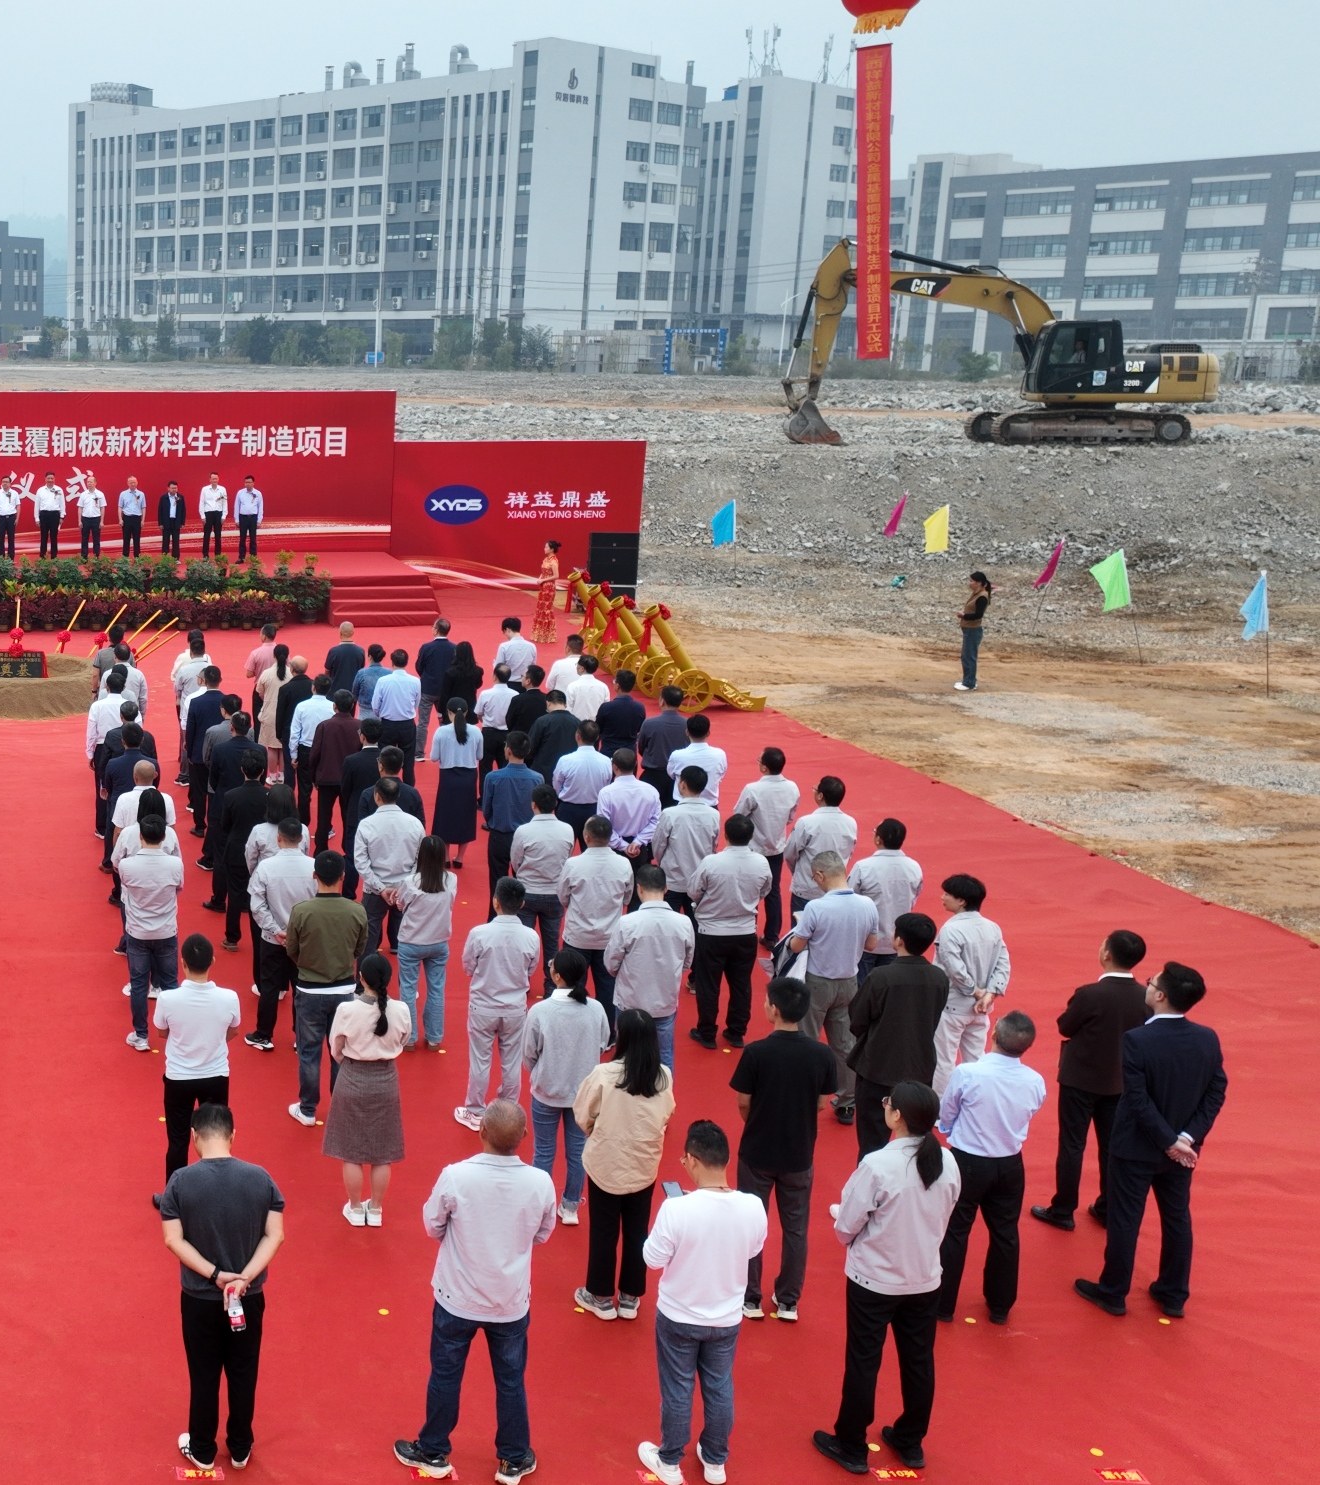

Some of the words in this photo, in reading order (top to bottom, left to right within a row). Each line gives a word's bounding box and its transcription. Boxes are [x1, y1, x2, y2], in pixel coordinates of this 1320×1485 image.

[910, 278, 937, 296] CAT
[1125, 361, 1146, 372] CAT
[430, 498, 483, 511] XYDS
[504, 490, 611, 508] 祥益鼎盛
[507, 510, 536, 519] XIANG
[538, 510, 547, 519] YI
[549, 510, 572, 519] DING
[573, 510, 606, 519] SHENG
